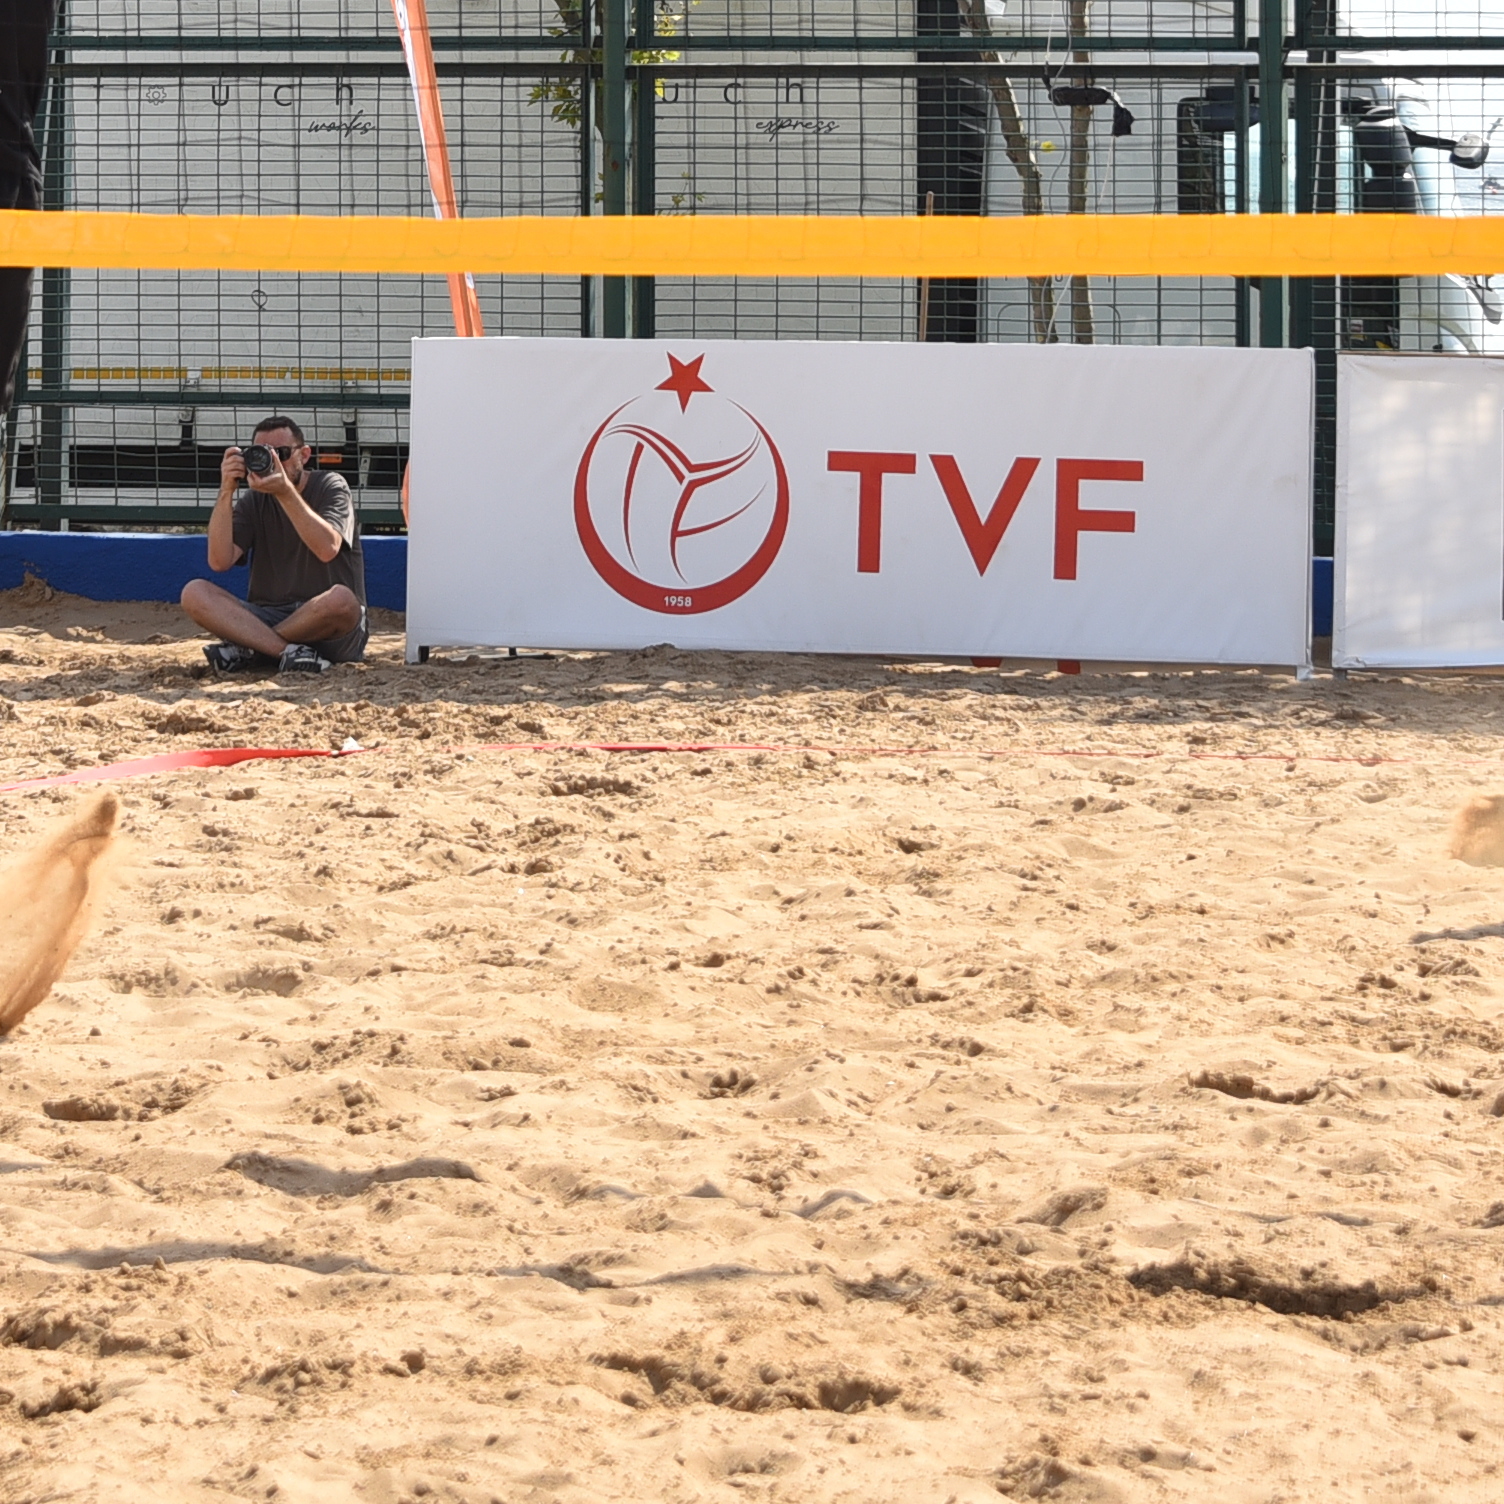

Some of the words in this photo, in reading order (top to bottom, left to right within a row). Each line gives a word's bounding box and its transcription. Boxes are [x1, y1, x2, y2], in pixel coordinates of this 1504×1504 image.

[755, 118, 840, 142] express
[827, 450, 1145, 581] TVF
[664, 596, 692, 607] 1958
